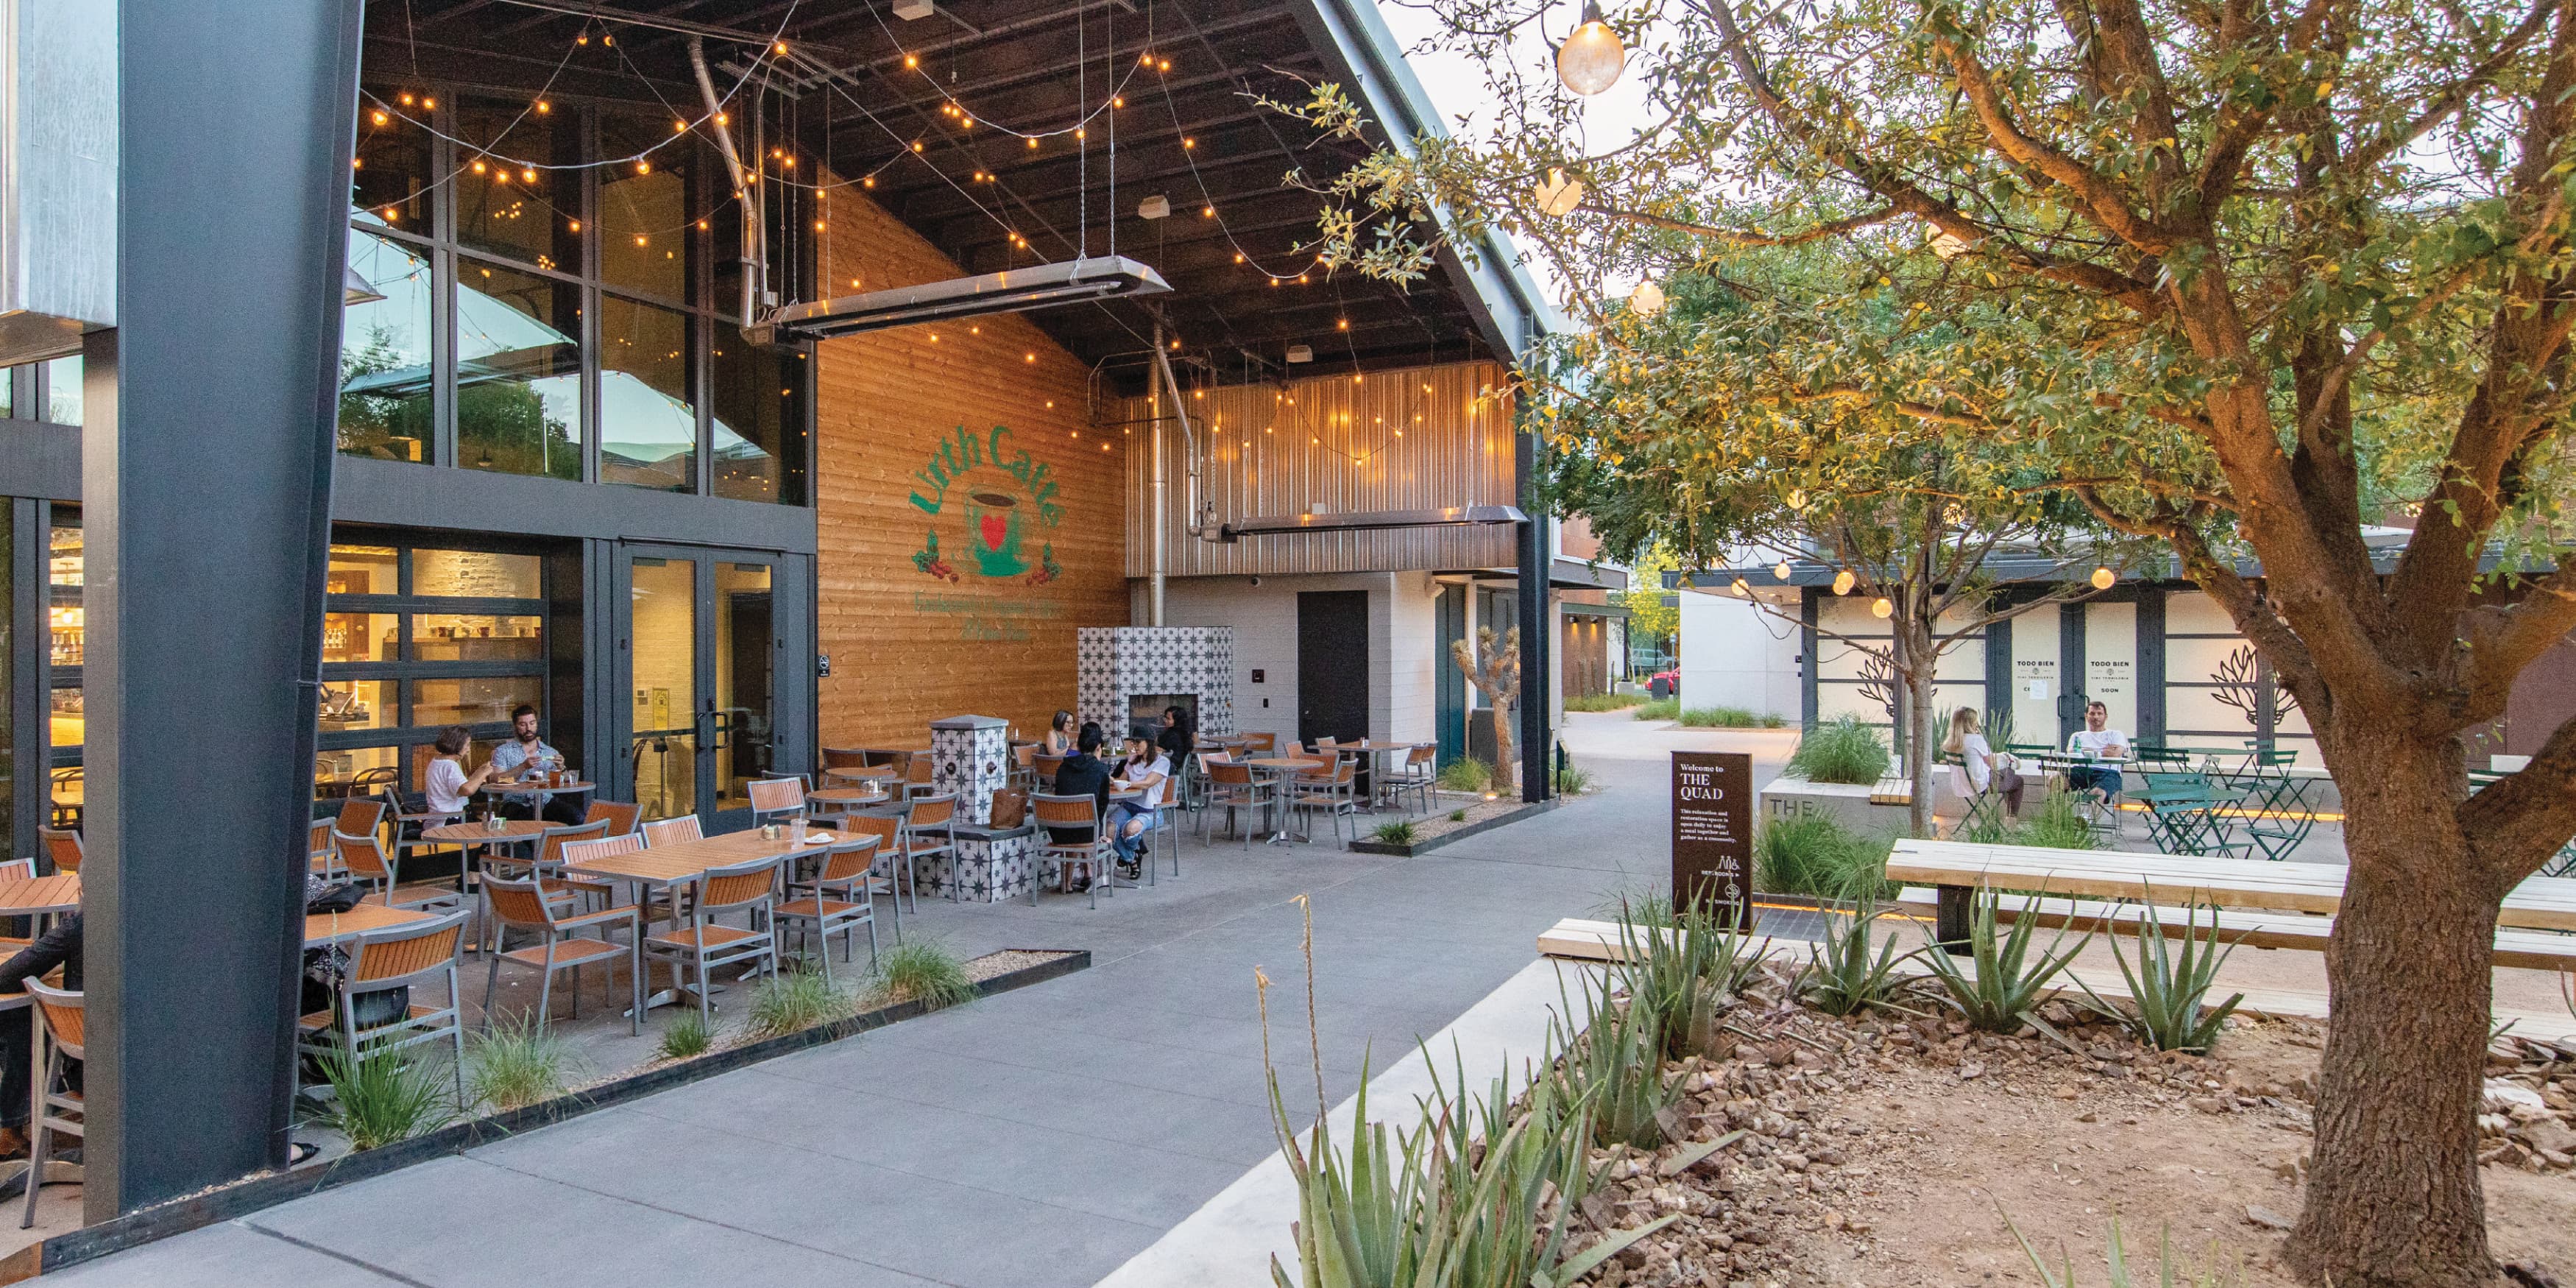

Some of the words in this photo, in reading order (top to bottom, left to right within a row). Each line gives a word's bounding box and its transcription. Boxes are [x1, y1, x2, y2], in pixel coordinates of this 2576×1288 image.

[909, 424, 982, 514] Urth
[1680, 763, 1714, 772] Welcome
[1680, 773, 1710, 785] THE
[1680, 786, 1723, 801] QUAD
[1769, 799, 1813, 816] THE
